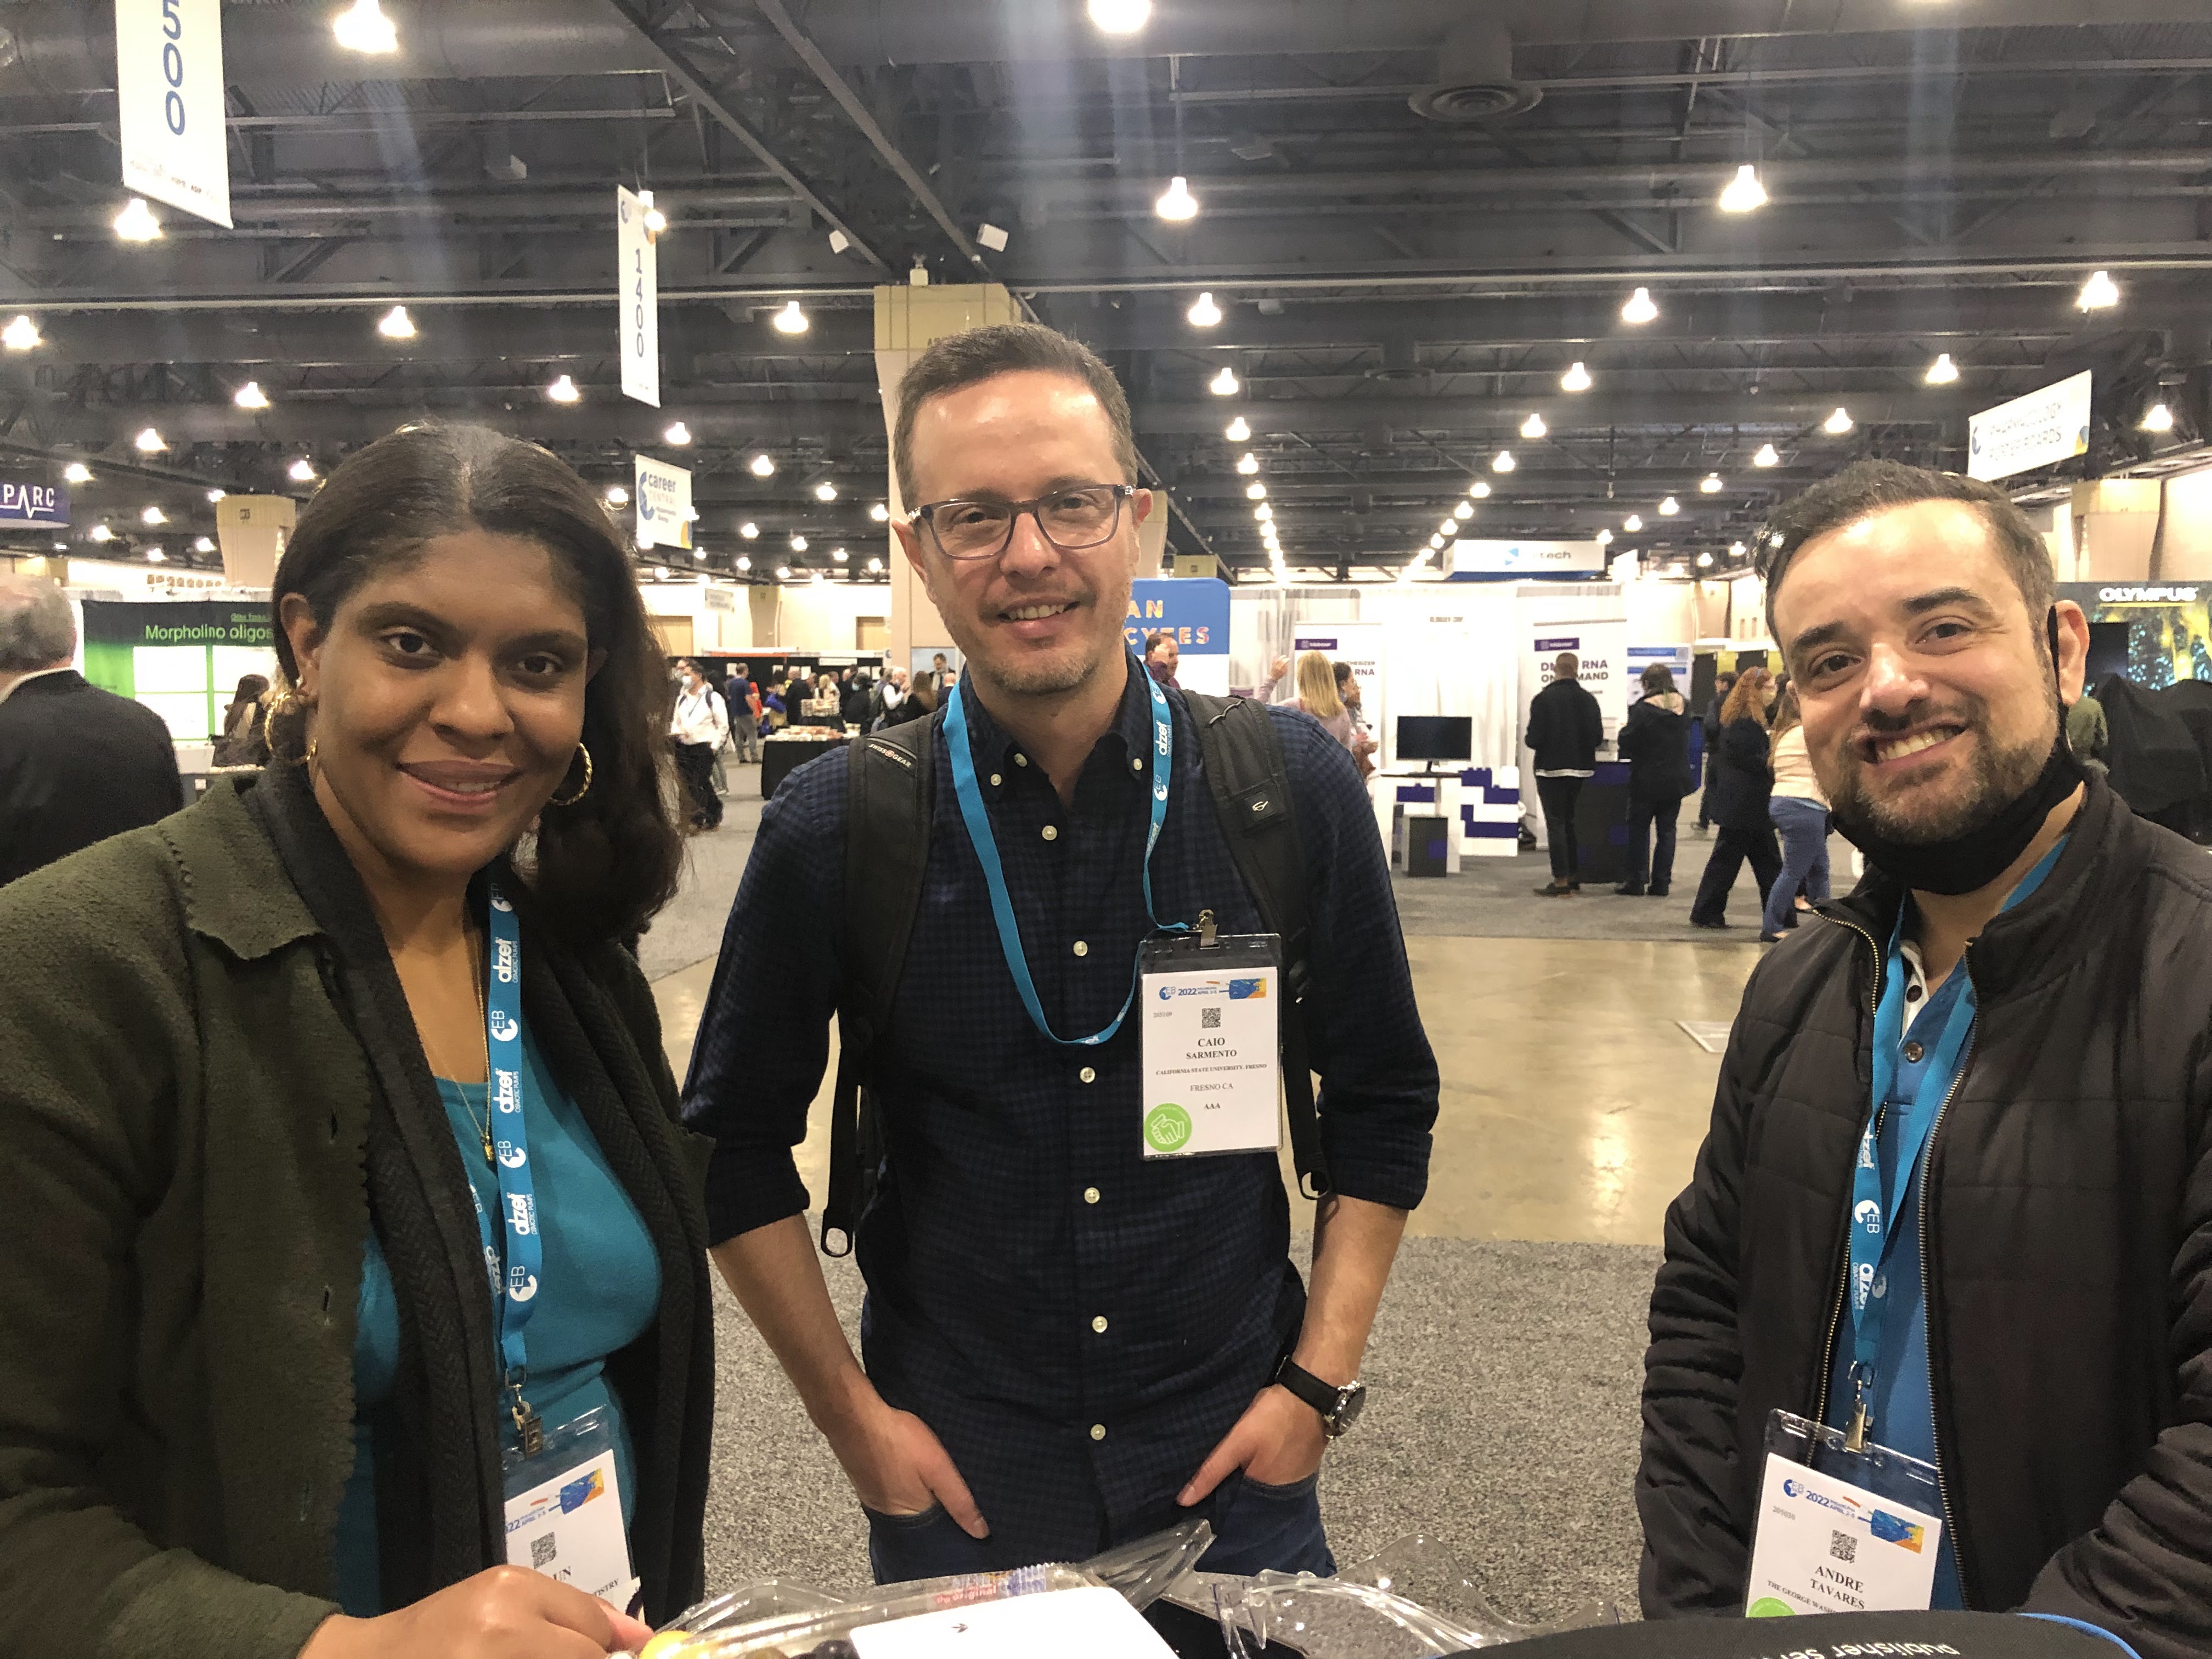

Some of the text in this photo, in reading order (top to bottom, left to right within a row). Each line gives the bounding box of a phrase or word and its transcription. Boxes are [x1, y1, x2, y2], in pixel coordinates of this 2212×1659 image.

[635, 248, 644, 358] 1400
[648, 473, 676, 493] career
[2100, 587, 2197, 601] OLYMPUS
[145, 624, 274, 643] Morpholino oligos
[1582, 659, 1608, 669] RNA
[1577, 671, 1609, 681] MAND
[868, 743, 911, 768] SWISS GEAR
[493, 936, 513, 983] alzet
[1178, 988, 1197, 996] 2022
[1198, 1037, 1225, 1047] CAIO
[1186, 1049, 1237, 1059] SARMENTO
[493, 1068, 515, 1113] alzet
[1190, 1084, 1221, 1092] FRESNO
[506, 1192, 529, 1235] alzet
[1805, 1490, 1830, 1508] 2022
[1815, 1565, 1865, 1593] ANDRE
[1767, 1581, 1838, 1613] THE GEORGE WASH
[1810, 1578, 1865, 1610] TAVARES
[1831, 1642, 1961, 1657] publisher
